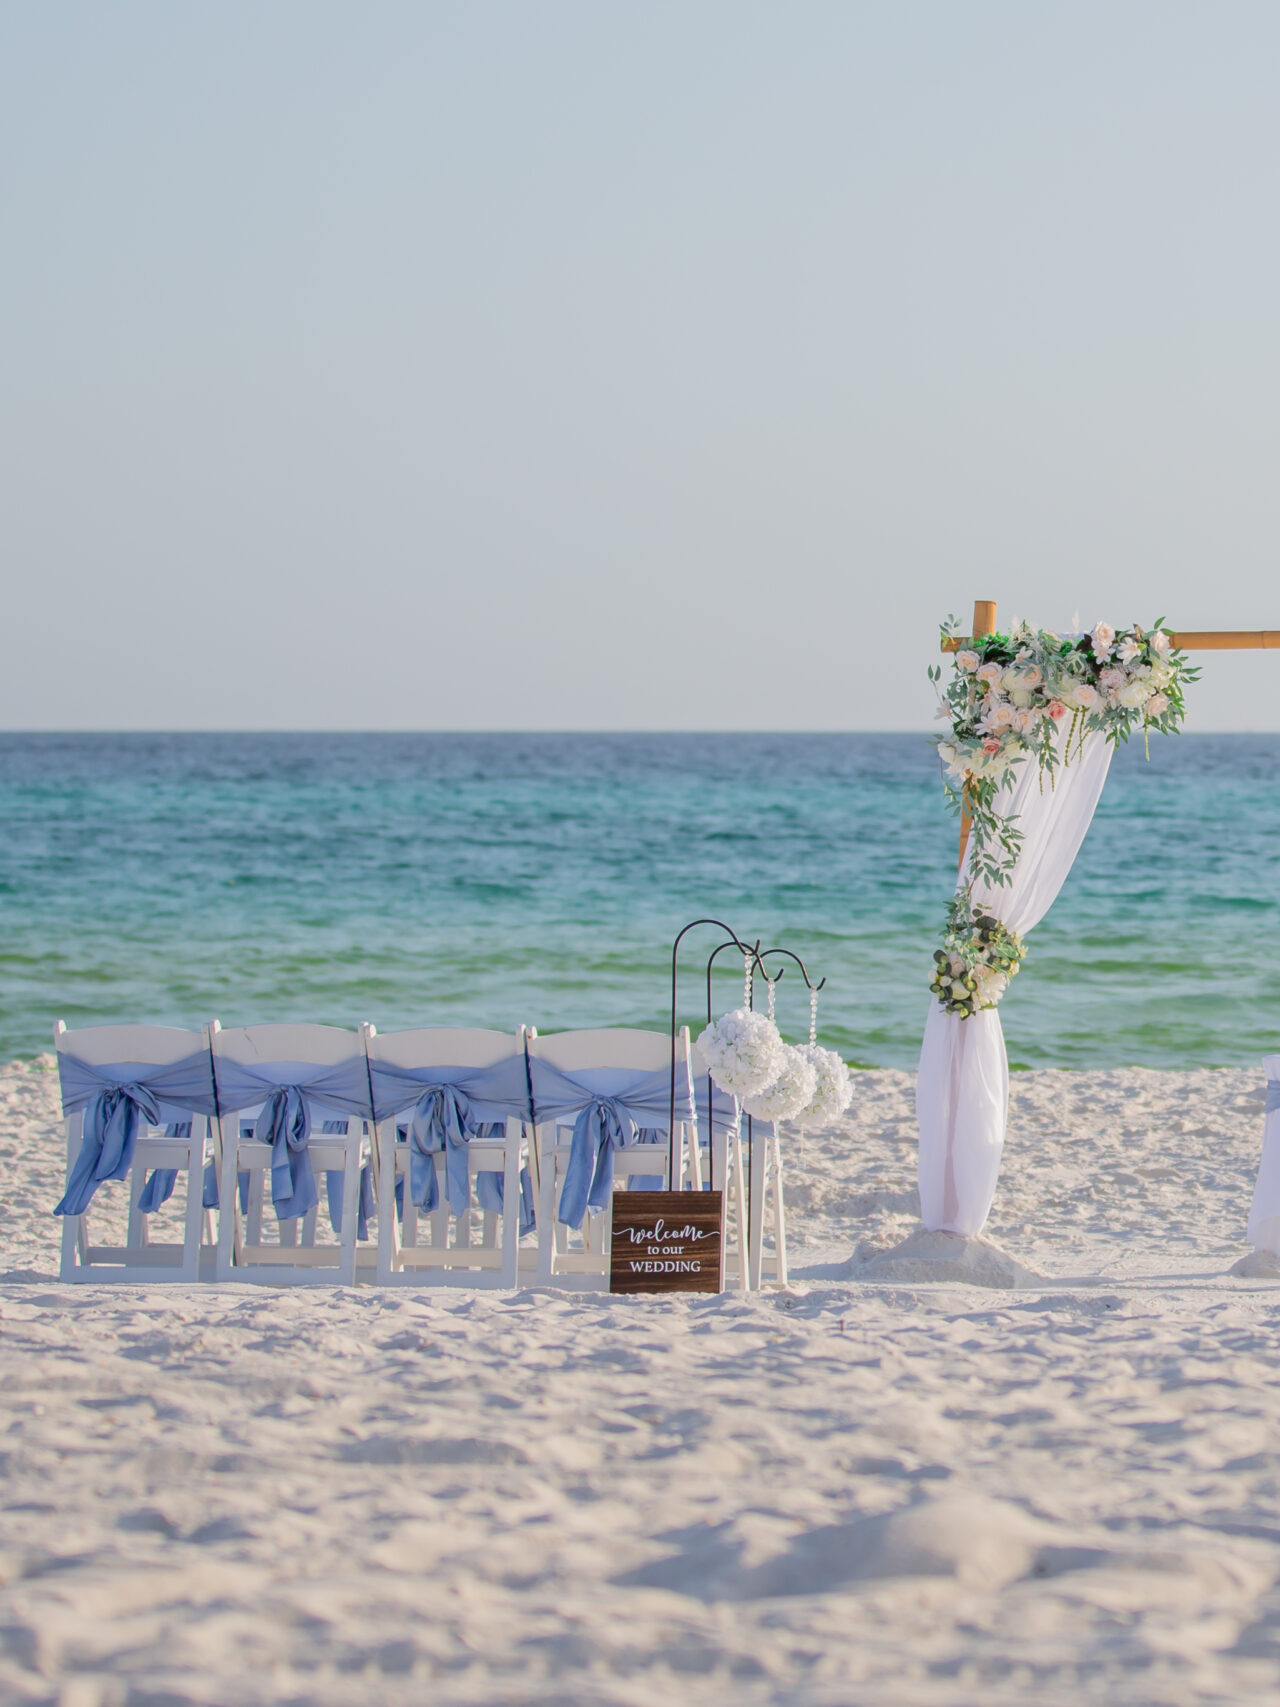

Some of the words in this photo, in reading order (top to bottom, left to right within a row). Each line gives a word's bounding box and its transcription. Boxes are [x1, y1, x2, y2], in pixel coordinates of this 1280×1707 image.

[612, 1218, 720, 1244] welcome
[647, 1245, 660, 1255] to
[662, 1246, 685, 1255] our
[630, 1260, 701, 1273] WEDDING
